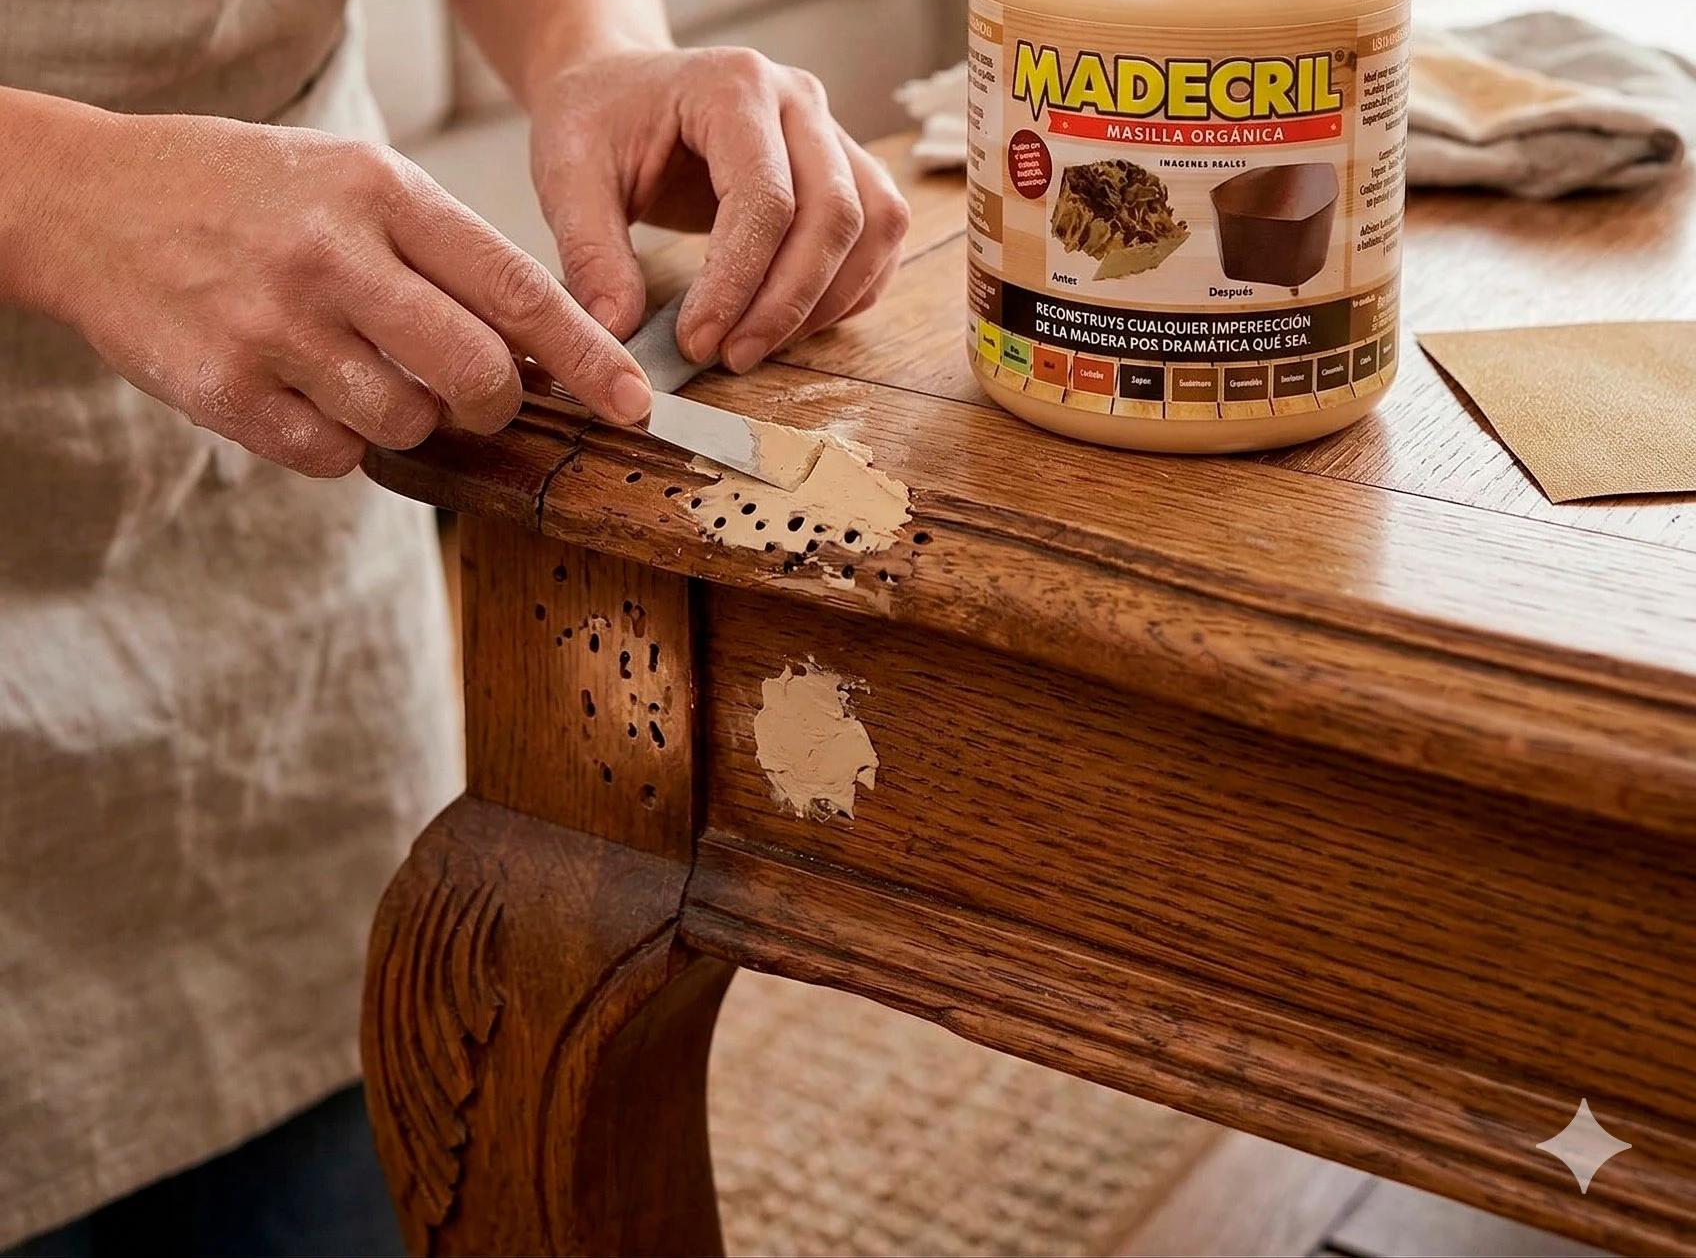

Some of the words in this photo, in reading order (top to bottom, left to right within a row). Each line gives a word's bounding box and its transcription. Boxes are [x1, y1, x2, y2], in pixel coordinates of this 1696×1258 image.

[1012, 39, 1343, 122] MADECRIL
[1106, 124, 1184, 143] MASILLA
[1190, 126, 1285, 143] ORGÁNICA
[1051, 272, 1078, 285] Antes
[1208, 285, 1254, 300] Después
[1036, 301, 1125, 331] RECONSTRUYS
[1127, 318, 1209, 336] CUALQUIER
[1035, 319, 1050, 334] DE
[1052, 324, 1068, 340] LA
[1070, 328, 1127, 349] MADERA
[1162, 336, 1250, 353] DRAMÁTICA
[1252, 333, 1282, 352] QUÉ
[1284, 333, 1311, 348] SEA.
